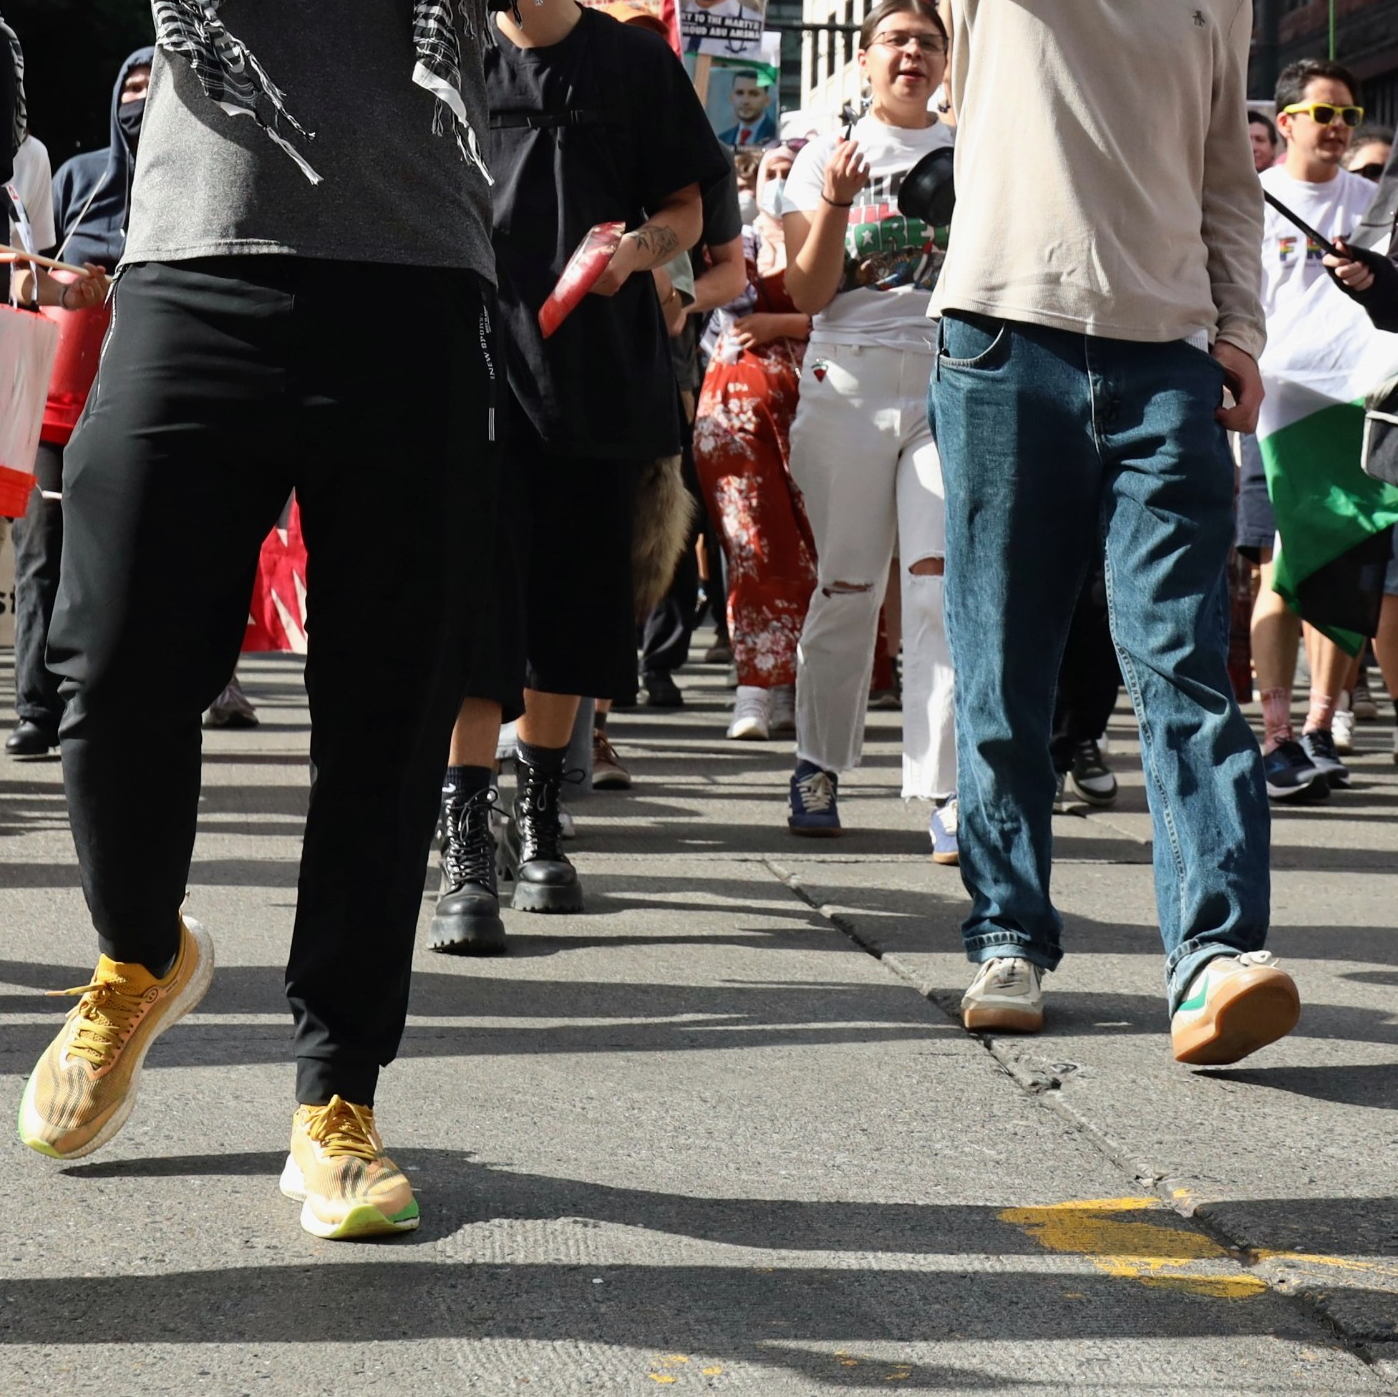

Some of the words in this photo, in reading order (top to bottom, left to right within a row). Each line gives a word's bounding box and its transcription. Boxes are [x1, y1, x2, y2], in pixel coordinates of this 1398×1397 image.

[694, 13, 706, 22] TO
[707, 15, 722, 25] THE
[709, 27, 728, 37] ABU
